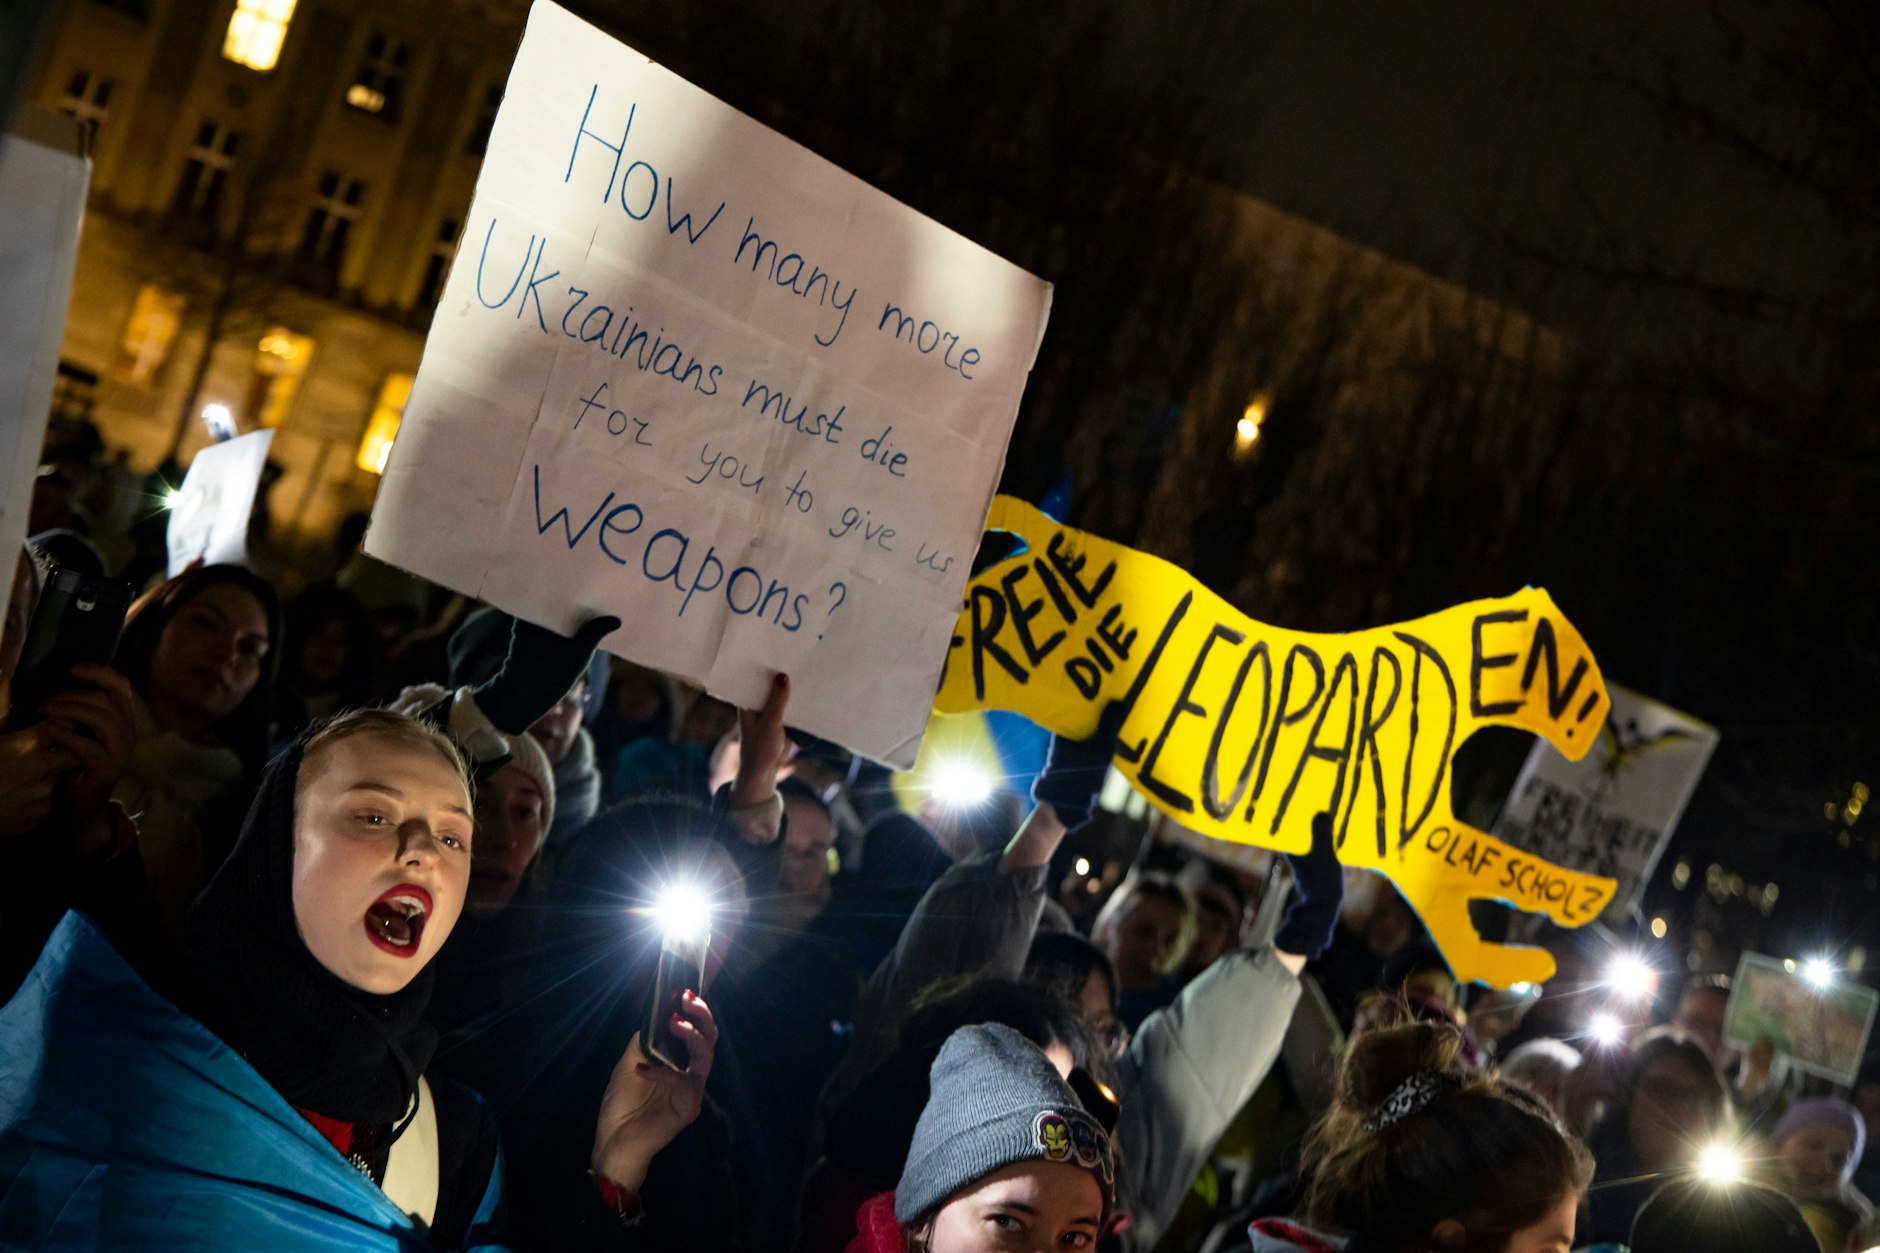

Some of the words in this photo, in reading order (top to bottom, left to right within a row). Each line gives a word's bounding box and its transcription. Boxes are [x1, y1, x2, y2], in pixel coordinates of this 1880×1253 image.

[565, 84, 725, 245] How
[734, 217, 857, 347] many
[879, 302, 981, 380] more
[477, 218, 723, 396] Ukrainians
[742, 380, 846, 444] must
[860, 426, 909, 478] die
[573, 383, 653, 447] for
[687, 441, 766, 494] you
[784, 470, 814, 514] to
[829, 505, 896, 552] give
[916, 543, 954, 573] us
[1065, 603, 1137, 701] DIE
[1426, 827, 1500, 877] OLAF
[1500, 859, 1603, 919] SCHOLZ
